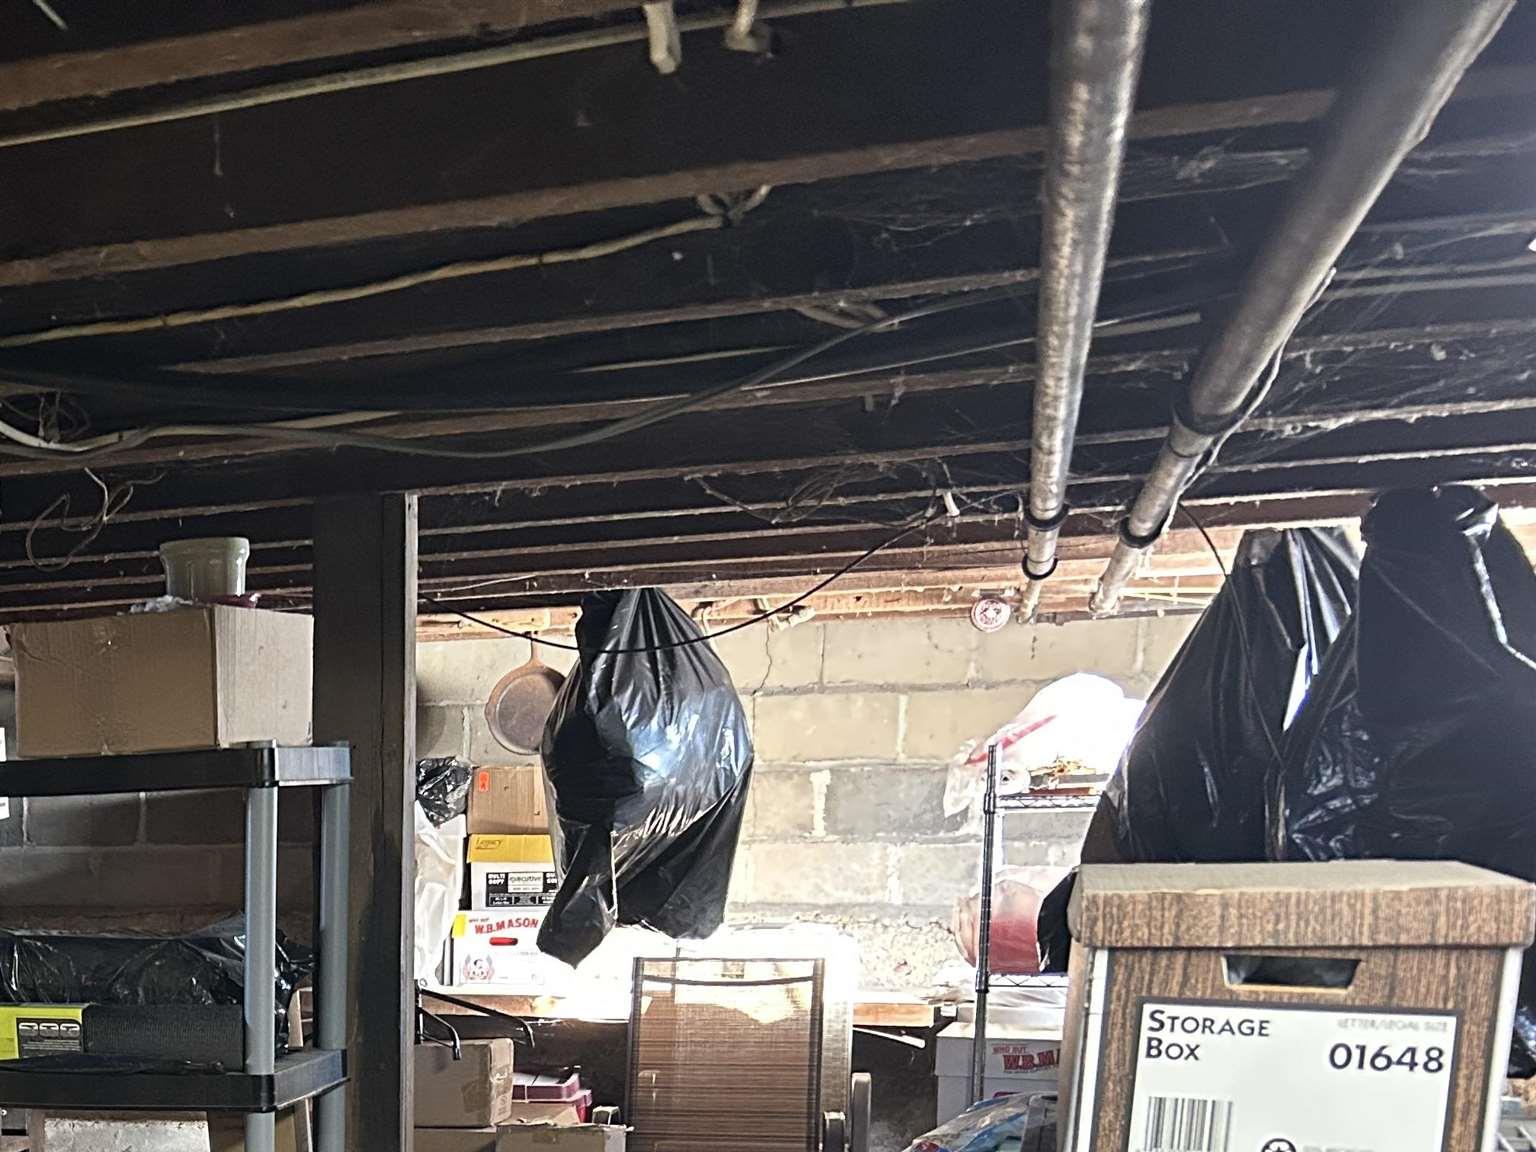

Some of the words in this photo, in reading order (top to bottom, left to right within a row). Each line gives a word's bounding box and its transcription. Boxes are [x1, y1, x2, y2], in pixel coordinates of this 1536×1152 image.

[1147, 1009, 1271, 1038] STORAGE
[1145, 1036, 1201, 1062] BOX
[1328, 1042, 1445, 1074] 01648
